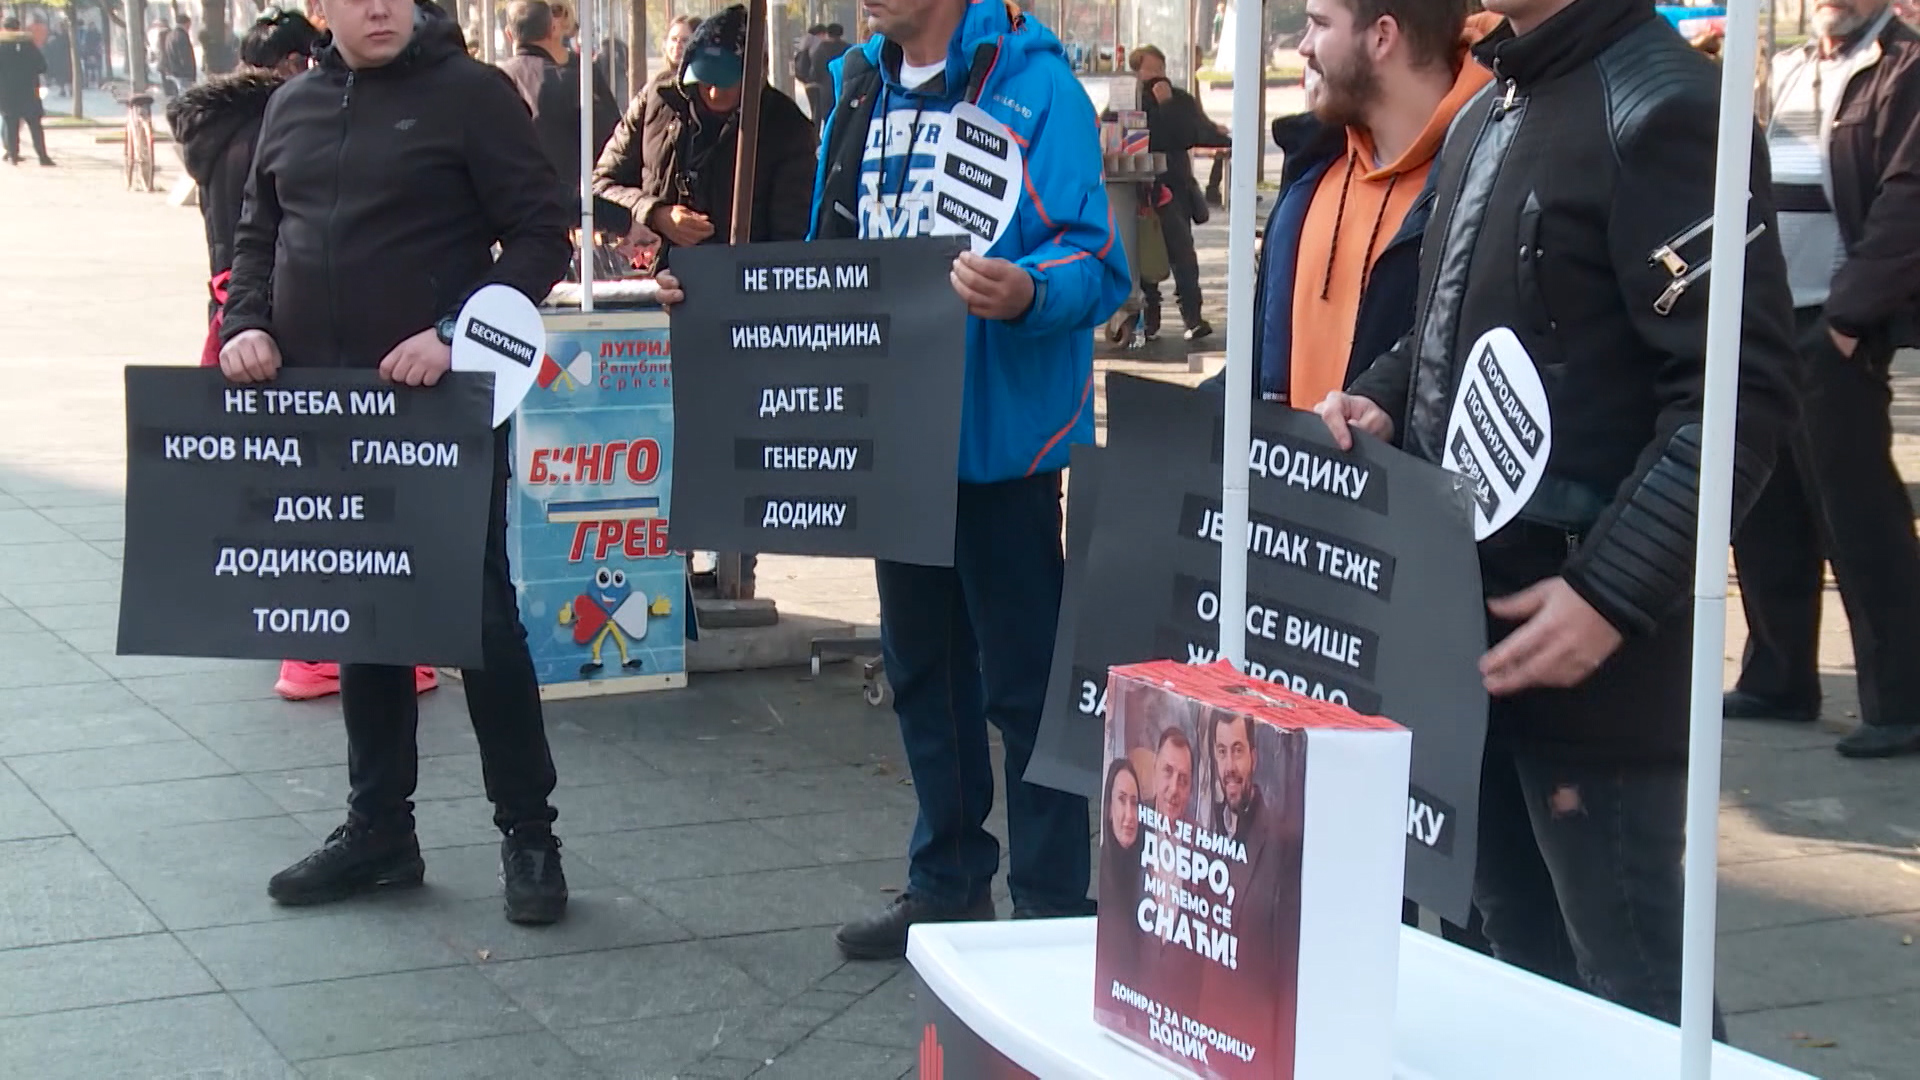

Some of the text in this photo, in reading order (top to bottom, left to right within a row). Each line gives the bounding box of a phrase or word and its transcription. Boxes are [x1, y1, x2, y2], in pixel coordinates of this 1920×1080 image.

[965, 126, 1001, 152] РАТНИ
[958, 162, 993, 189] ВОЈНИ
[942, 197, 992, 236] ИНВАЛИД
[744, 265, 869, 291] НЕ ТРЕБА МИ
[471, 322, 533, 361] БЕСКУЋНИК
[600, 340, 671, 357] ЛУТРИЈ
[731, 322, 881, 352] ИНВАЛИДНИНА
[600, 360, 672, 377] Републи
[600, 375, 671, 391] Српск
[225, 389, 396, 415] НЕ ТРЕБА МИ
[759, 387, 844, 418] ДАЈТЕ ЈЕ
[1483, 351, 1537, 448] ПОРОДИЦА
[1467, 386, 1523, 482] ПОГИНУЛОГ
[165, 436, 459, 467] КРОВ НАД ГЛАВОМ
[763, 446, 858, 470] ГЕНЕРАЛУ
[1249, 438, 1369, 500] ДОДИКУ
[274, 496, 365, 522] ДОК ЈЕ
[762, 501, 846, 530] ДОДИКУ
[568, 518, 673, 562] ГРЕБ
[215, 547, 412, 577] ДОДИКОВИМА
[1316, 541, 1381, 592] ТЕЖЕ
[253, 608, 350, 633] ТОПЛО
[1196, 591, 1362, 668] О СЕ ВИШЕ
[1138, 803, 1248, 864] НЕКА ЈЕ ЊИМА
[1140, 831, 1235, 905] ДОБРО,
[1144, 873, 1232, 929] МИ ЋЕМО СЕ
[1137, 898, 1238, 970] СНАЋИ!
[1111, 980, 1256, 1062] ДОНИРАЈ ЗА ПОРОДИЦУ
[1149, 1017, 1209, 1065] ДОДИК
